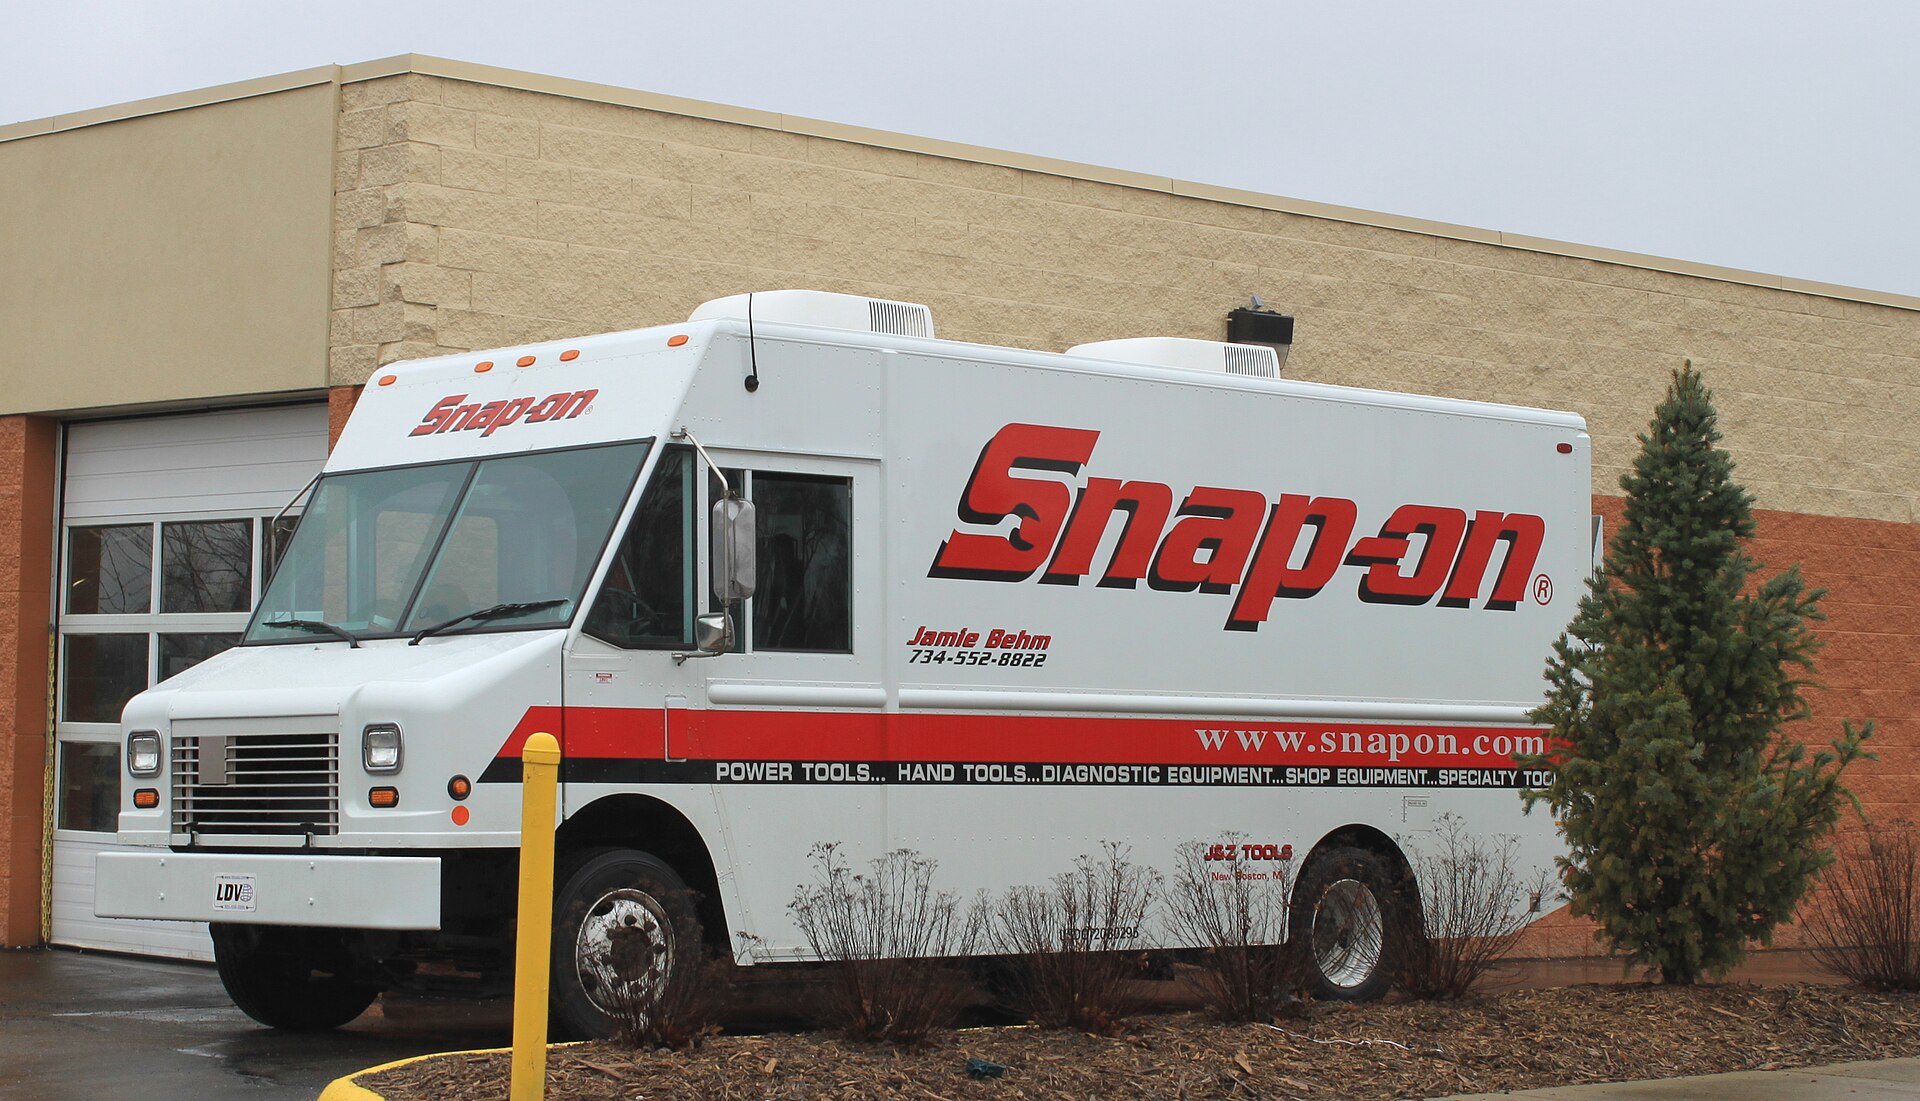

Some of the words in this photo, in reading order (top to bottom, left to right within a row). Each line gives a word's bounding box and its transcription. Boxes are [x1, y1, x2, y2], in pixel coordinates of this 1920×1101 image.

[408, 389, 599, 437] Snap-on
[926, 423, 1545, 632] Snap-on
[907, 626, 979, 648] Jamie
[985, 629, 1051, 650] Behm
[909, 650, 1047, 667] 734-552-8822
[1194, 729, 1544, 762] www.snapon.com
[716, 762, 793, 781] POWER
[898, 764, 955, 781] HAND
[1523, 770, 1556, 786] TOO
[1204, 844, 1236, 861] J&Z
[1241, 844, 1292, 861] TOOLS
[1211, 871, 1231, 881] New
[216, 883, 243, 902] LDV
